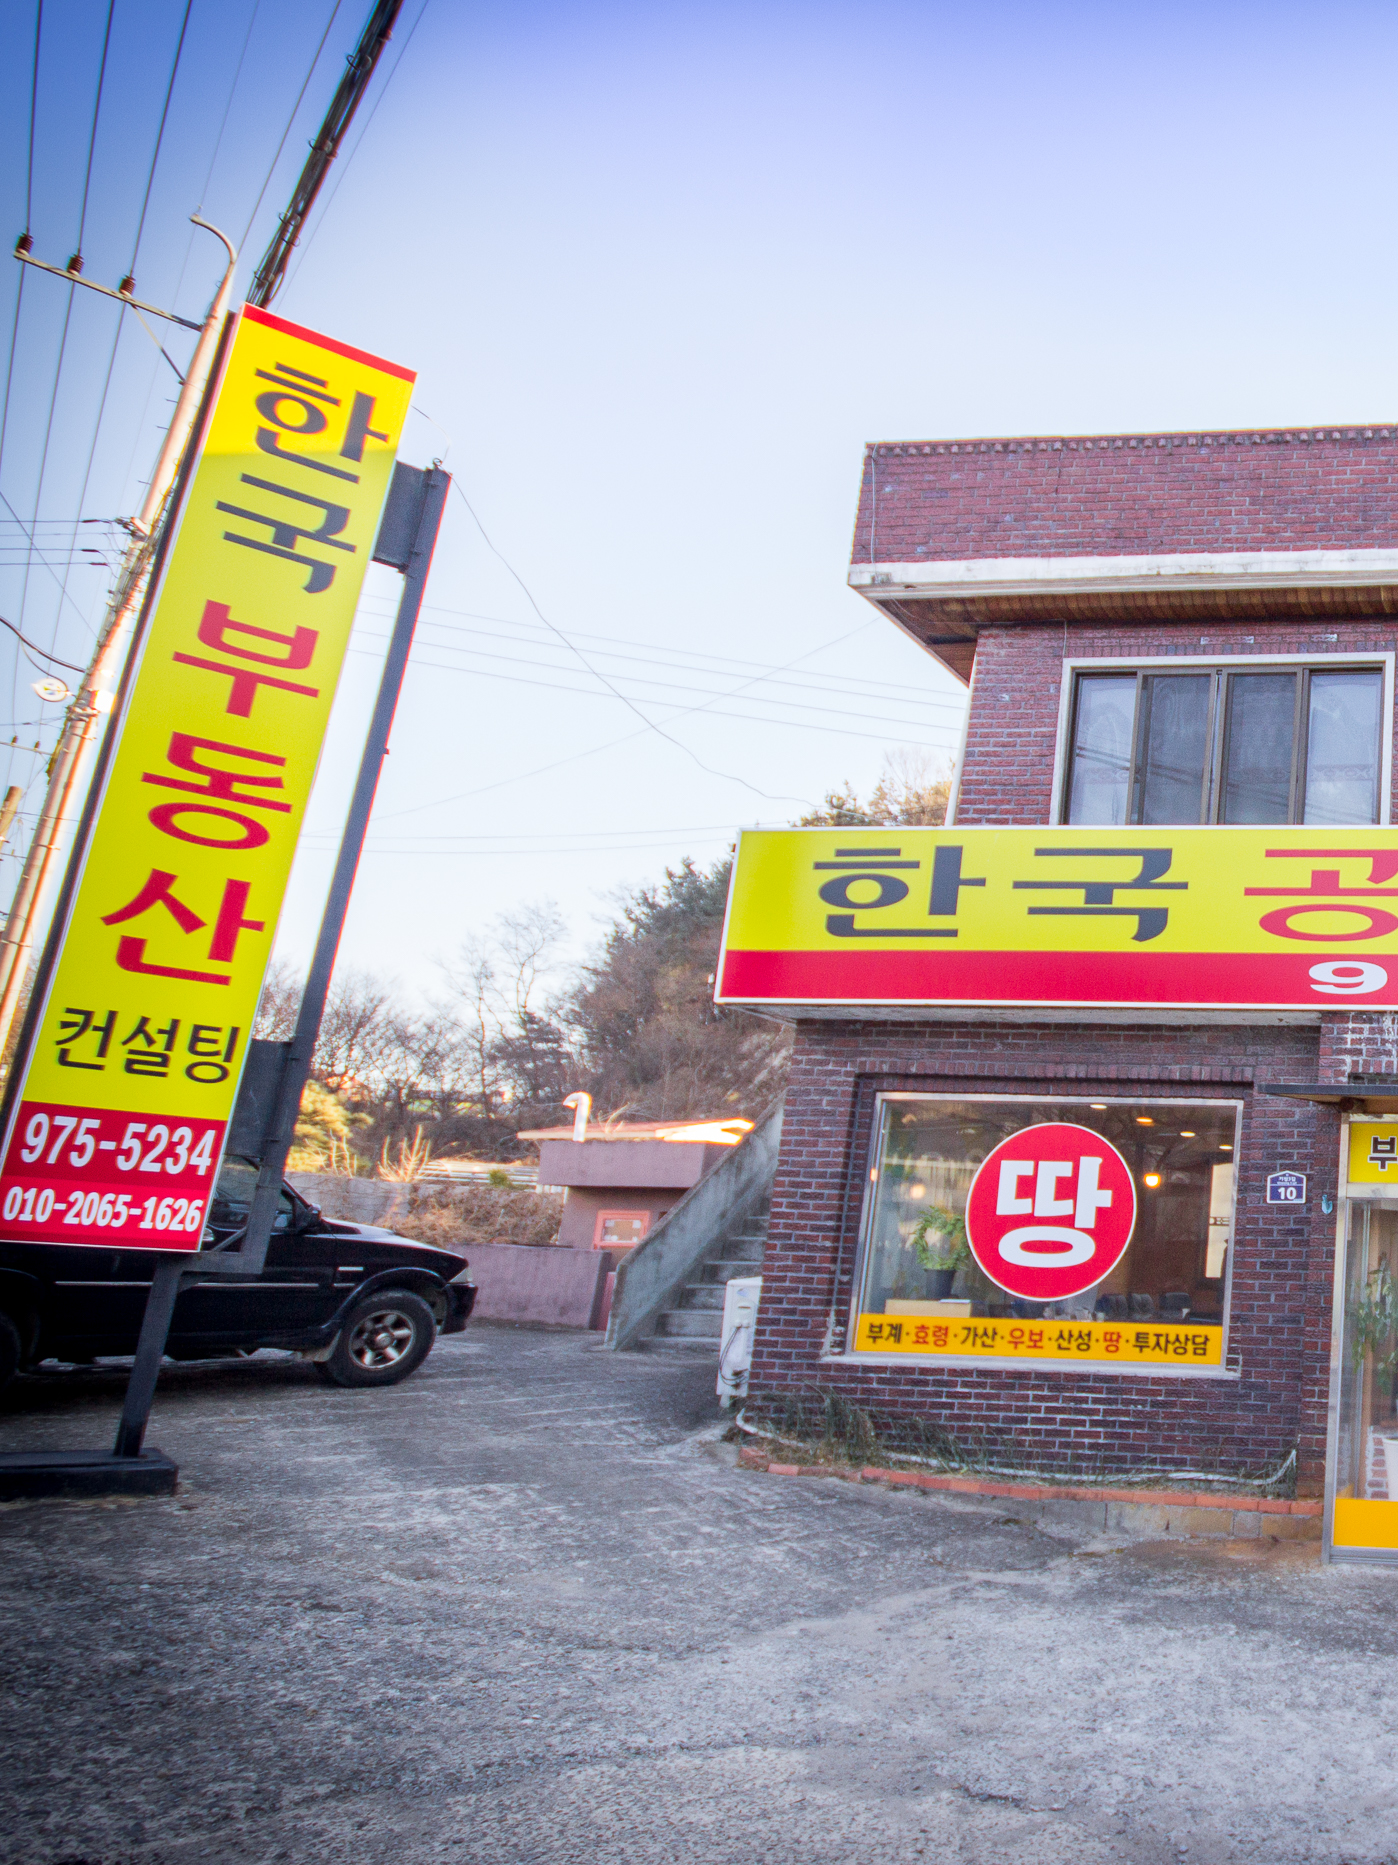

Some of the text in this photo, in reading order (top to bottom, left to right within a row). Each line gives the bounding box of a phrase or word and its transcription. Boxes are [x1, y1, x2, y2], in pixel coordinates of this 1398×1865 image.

[813, 844, 1189, 943] 한국
[53, 1007, 241, 1084] 컨설팅
[20, 1113, 216, 1176] 975-5234
[3, 1186, 203, 1232] 010-2065-1626
[996, 1156, 1113, 1268] 땅
[1277, 1187, 1297, 1200] 10
